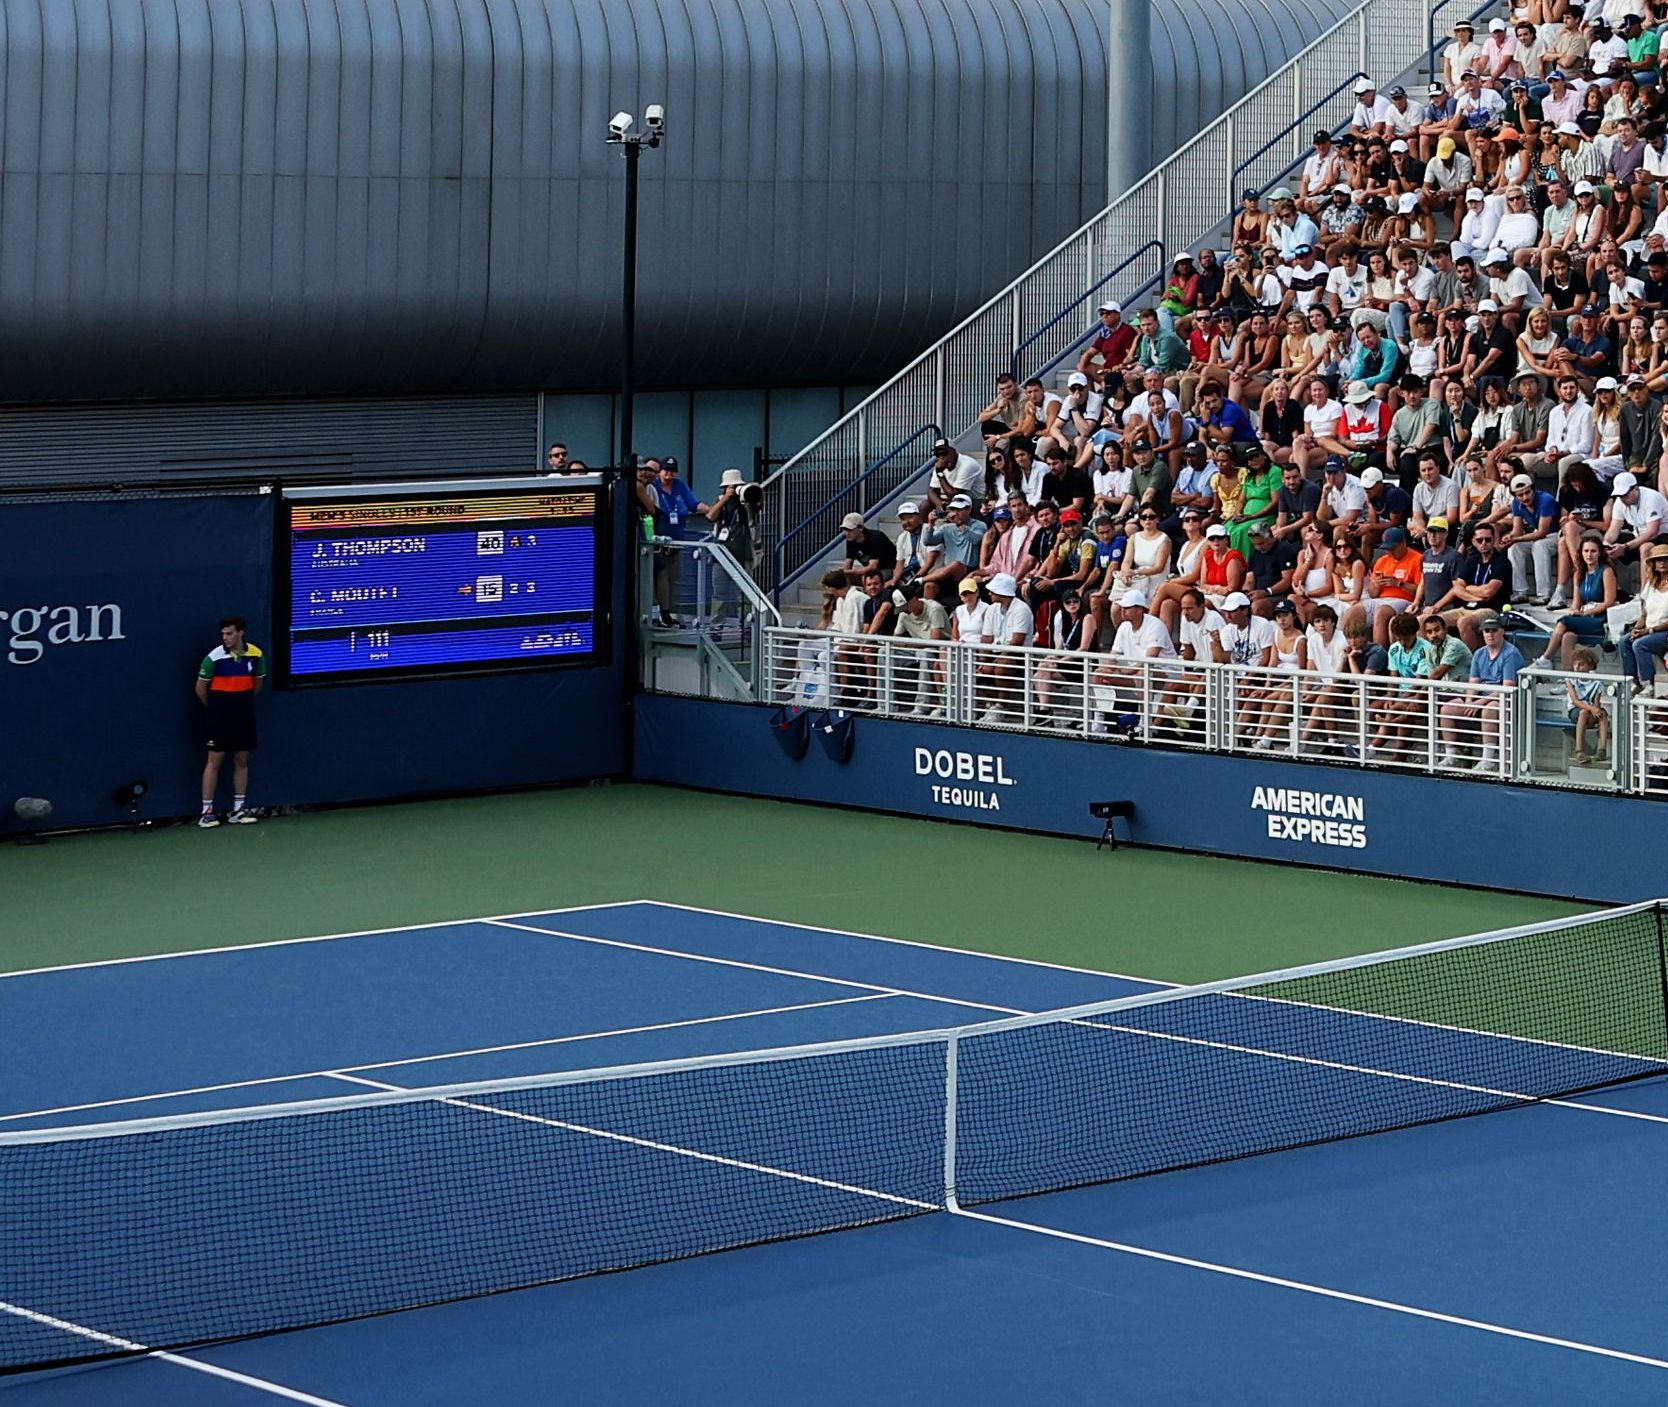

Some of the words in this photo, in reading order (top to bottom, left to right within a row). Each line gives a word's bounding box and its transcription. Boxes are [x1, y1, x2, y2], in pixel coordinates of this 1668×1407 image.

[312, 543, 328, 558] J.
[332, 538, 426, 557] THOMPSON
[527, 535, 537, 547] 3
[0, 604, 126, 665] gan
[368, 630, 389, 648] 111
[914, 747, 1014, 786] DOBEL
[931, 785, 1000, 811] TEQUILA
[1250, 786, 1365, 822] AMERICAN
[1267, 814, 1368, 849] EXPRESS
